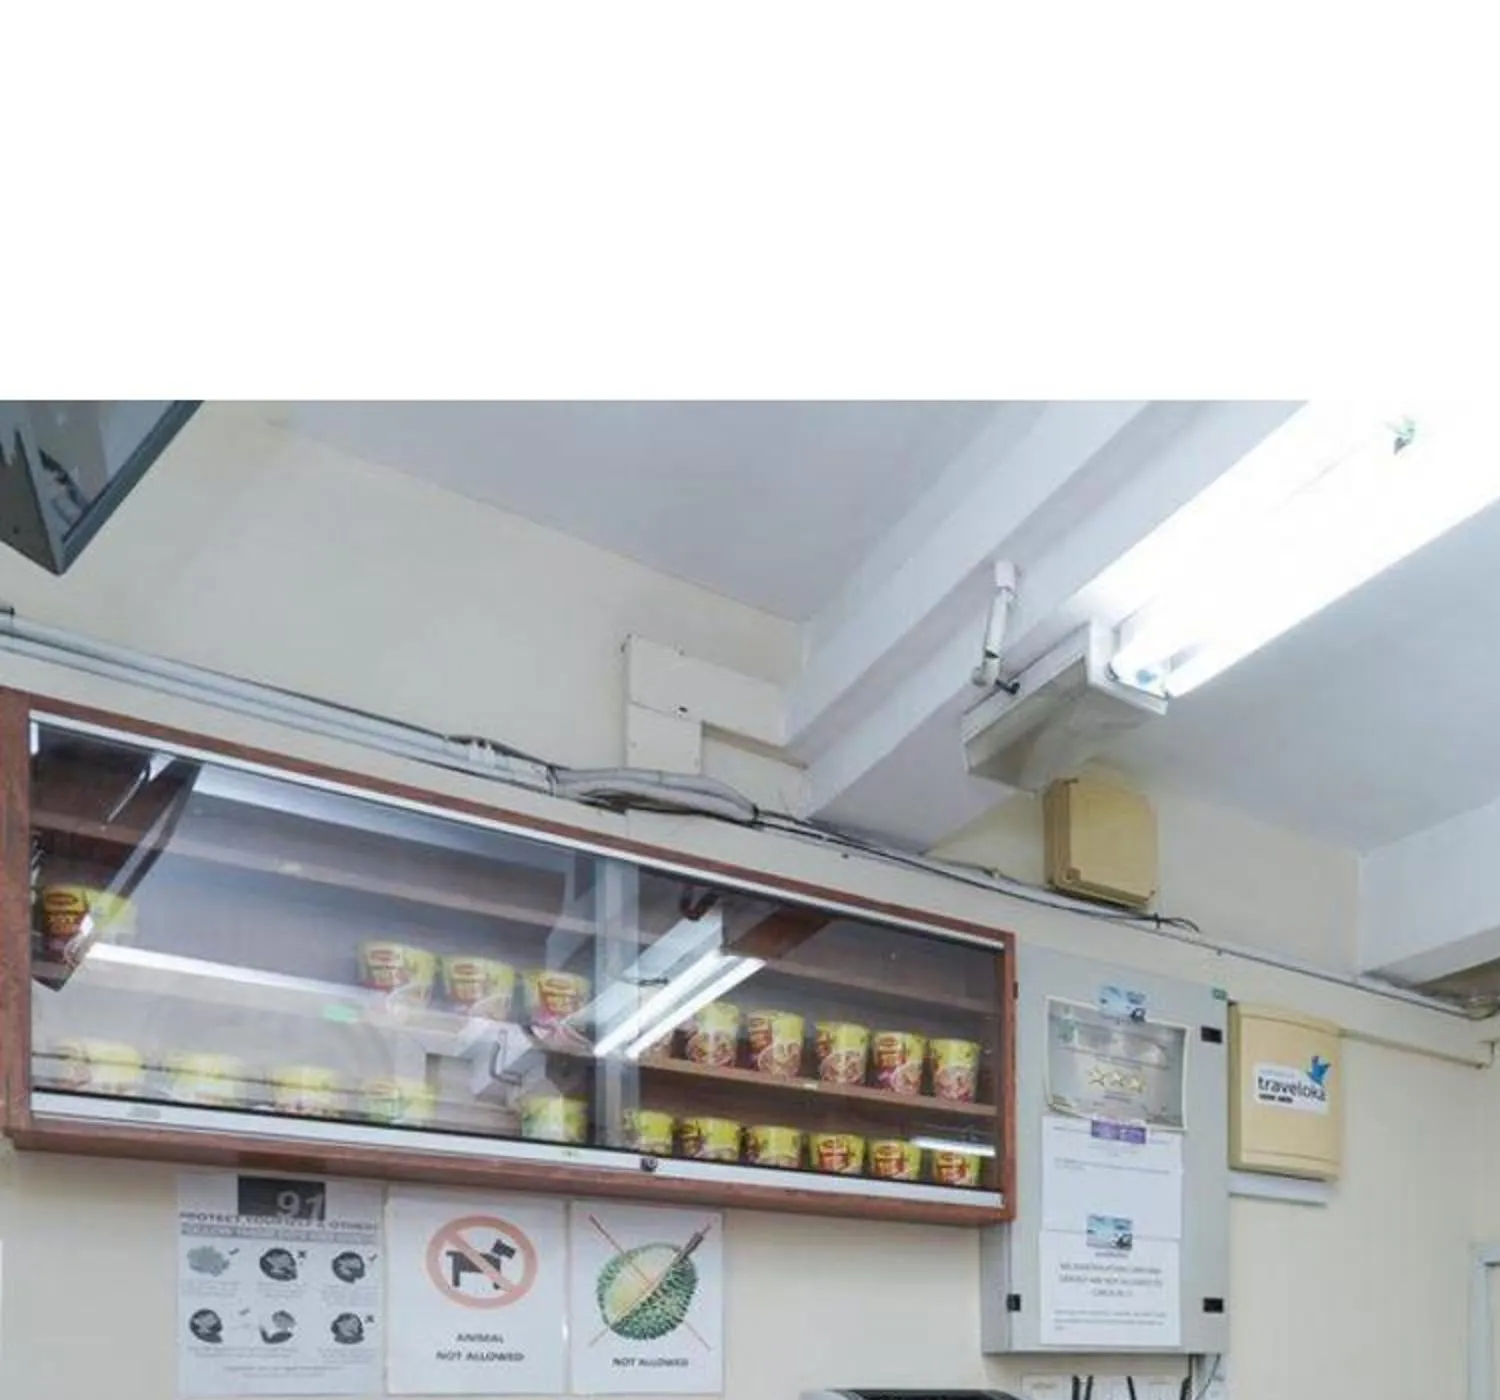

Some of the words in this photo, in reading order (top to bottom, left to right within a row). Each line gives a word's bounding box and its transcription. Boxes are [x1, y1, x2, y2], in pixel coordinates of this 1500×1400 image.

[1257, 1076, 1326, 1101] traveloka
[275, 1190, 326, 1221] 91
[456, 1333, 503, 1344] ANIMAL
[436, 1351, 462, 1362] NOT
[466, 1351, 525, 1362] ALLOWED
[612, 1357, 635, 1367] NOT
[638, 1358, 689, 1368] ALLOWED
